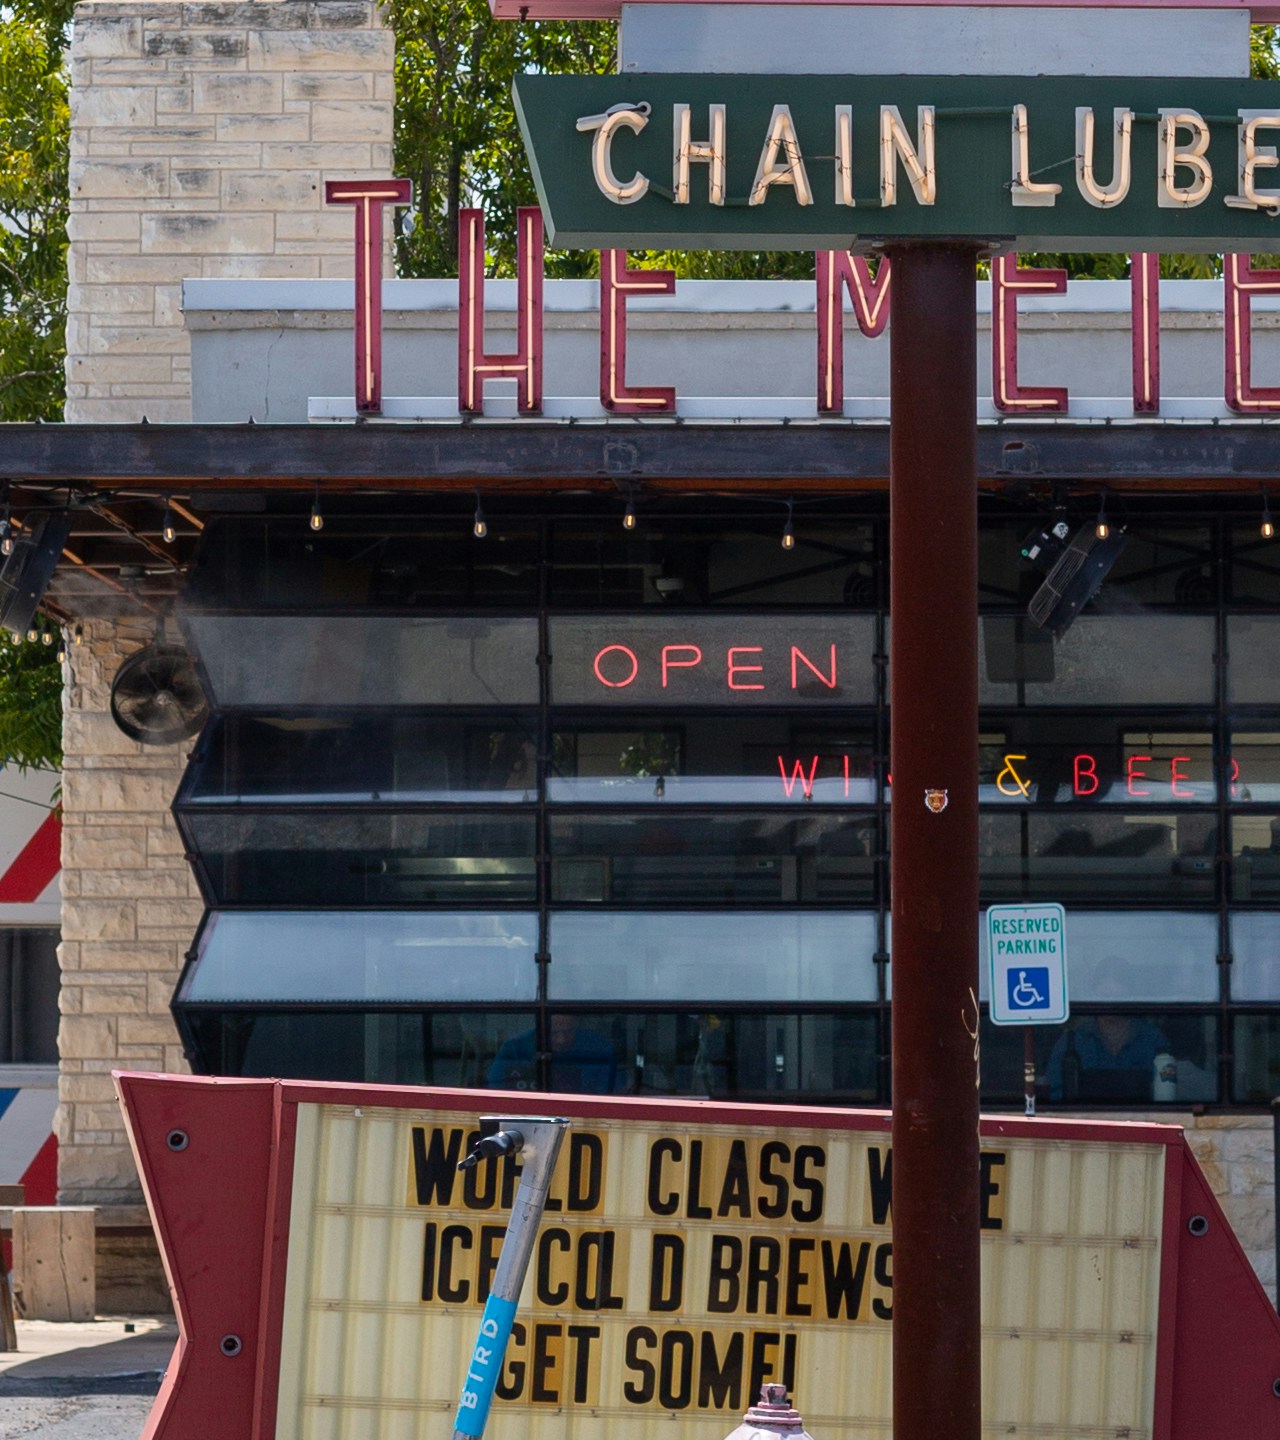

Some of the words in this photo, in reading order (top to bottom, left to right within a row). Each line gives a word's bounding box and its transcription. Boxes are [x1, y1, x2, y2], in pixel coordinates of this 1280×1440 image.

[590, 103, 937, 207] CHAIN
[325, 179, 677, 414] THE
[593, 643, 837, 690] OPEN
[996, 754, 1032, 799] &
[992, 917, 1060, 935] RESERVED
[997, 938, 1057, 955] PARKING
[647, 1137, 826, 1223] CLASS
[707, 1234, 893, 1321] BREWS
[460, 1318, 499, 1410] BIRD
[495, 1322, 601, 1404] GET
[624, 1325, 798, 1411] SOME!
